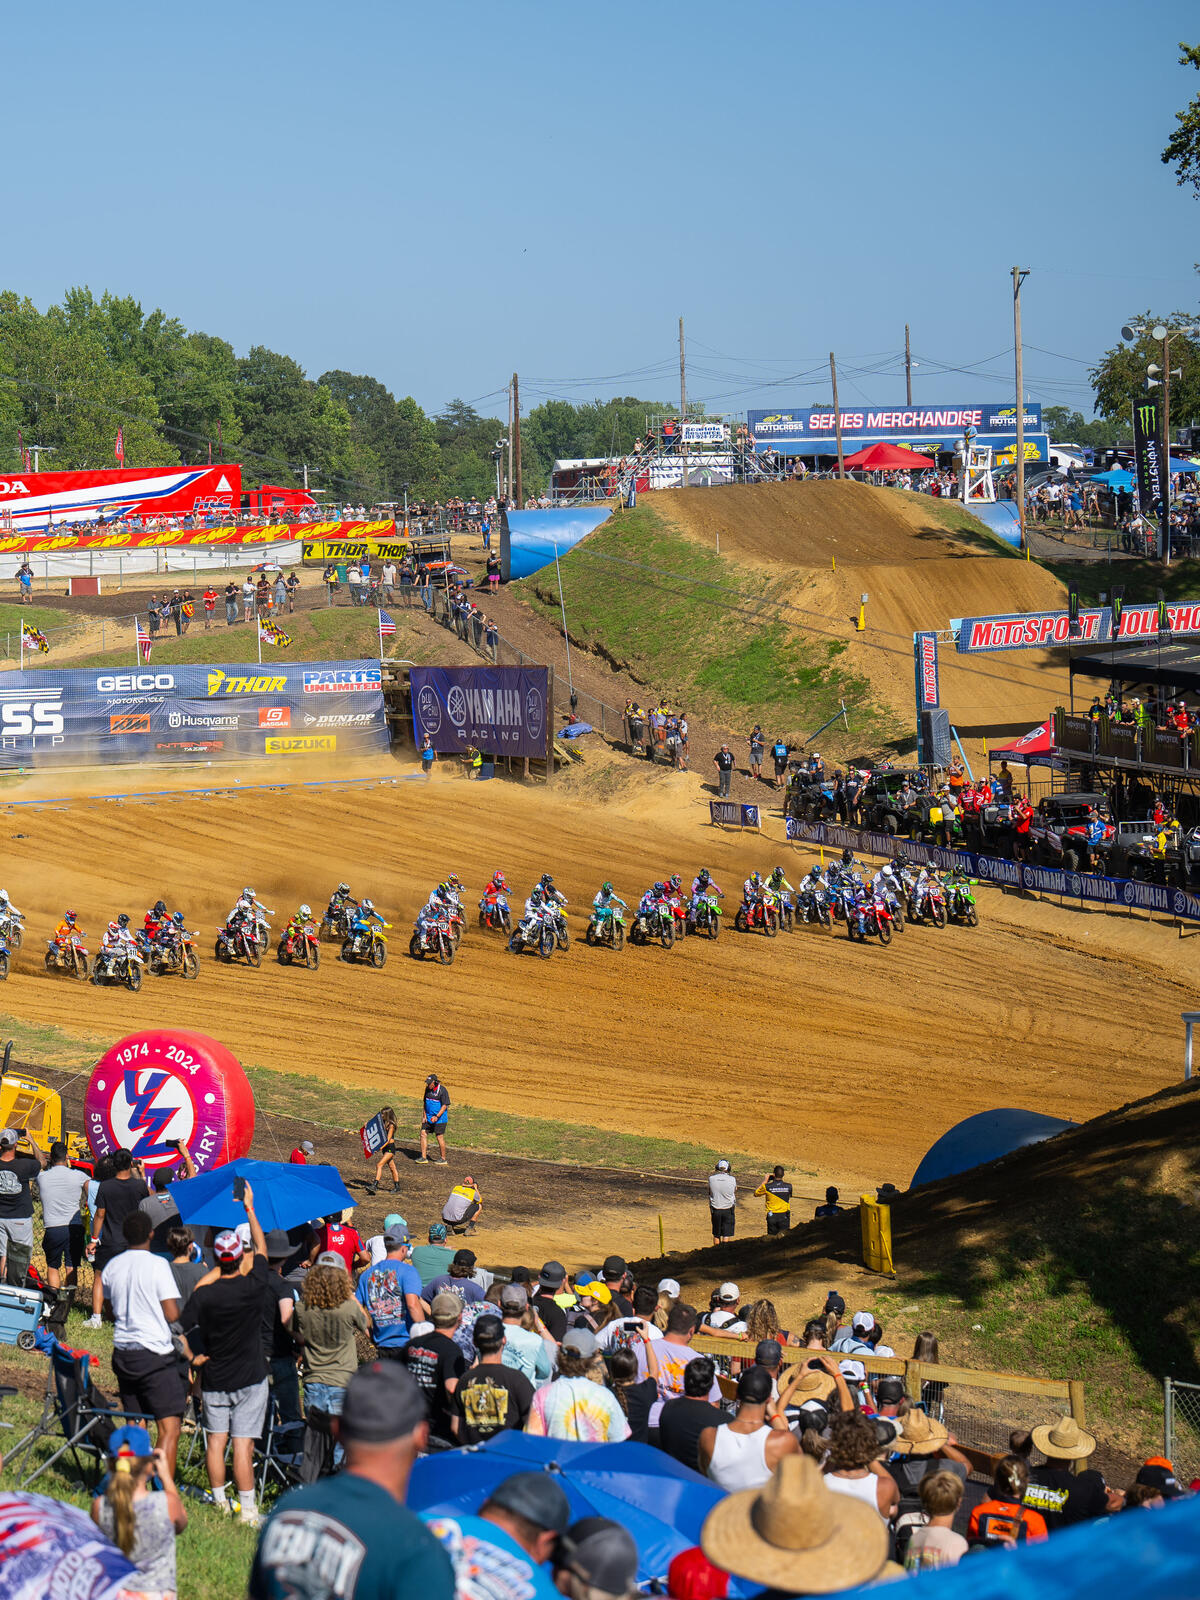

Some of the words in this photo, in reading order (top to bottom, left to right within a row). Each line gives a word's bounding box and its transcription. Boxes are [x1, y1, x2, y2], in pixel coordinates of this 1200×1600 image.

[867, 410, 982, 428] MERCHANDISE
[990, 416, 1037, 424] MOTOCOSS
[1147, 440, 1160, 500] MONSTER
[190, 527, 236, 544] FMF
[295, 522, 342, 540] FMF
[348, 520, 393, 538] FMF
[33, 537, 78, 550] FMF
[86, 534, 132, 547] FMF
[138, 531, 184, 546] FMF
[327, 543, 368, 556] THOR
[97, 674, 174, 692] GEICO
[225, 676, 288, 692] THOR
[304, 670, 380, 684] PARTS
[305, 682, 380, 692] UNLIMITED
[107, 696, 165, 704] MOTORCYCLE
[466, 688, 522, 726] YAMAHA
[112, 717, 148, 731] KTM
[182, 715, 239, 726] Husqvarna
[318, 714, 375, 722] DUNLOP
[458, 730, 520, 741] RACING
[270, 738, 330, 750] SUZUKI
[988, 862, 1020, 884] YAMAHA
[1033, 870, 1066, 892] YAMAHA
[1081, 876, 1117, 900] YAMAHA
[1134, 884, 1168, 908] YAMAHA
[116, 1042, 149, 1066] 1974
[165, 1046, 200, 1076] 2024
